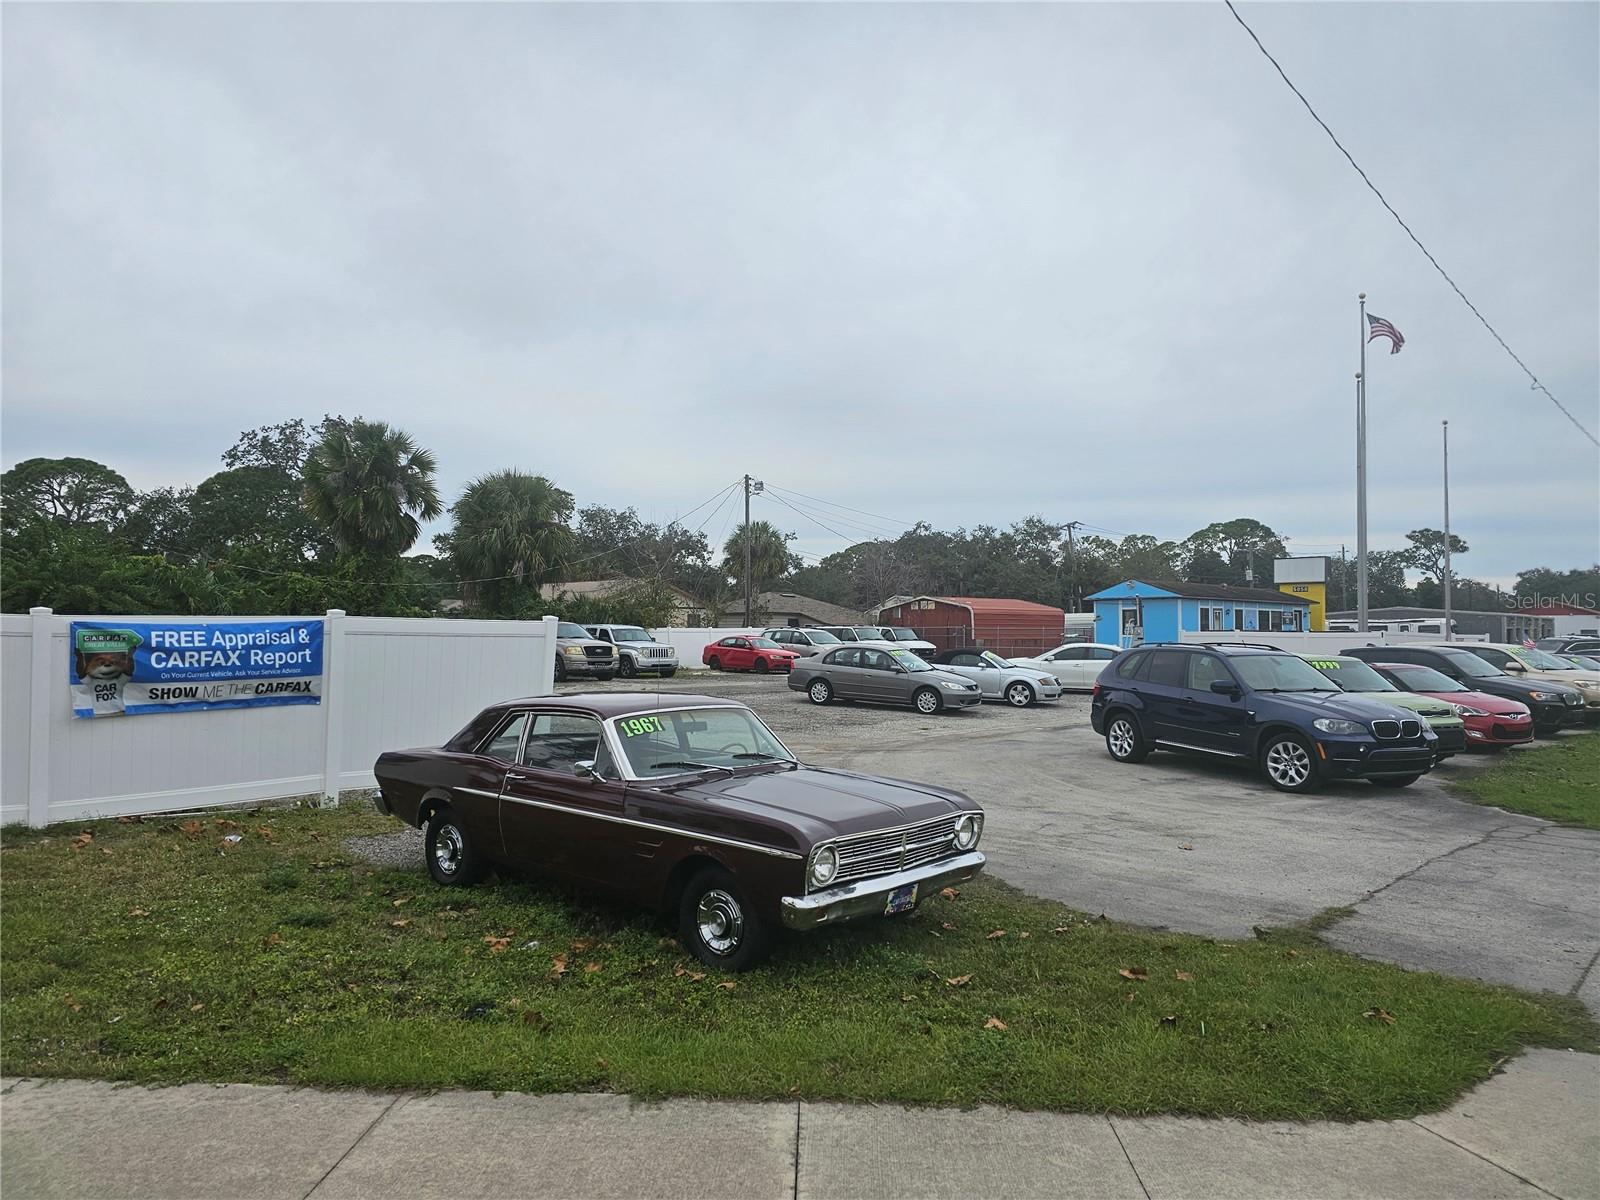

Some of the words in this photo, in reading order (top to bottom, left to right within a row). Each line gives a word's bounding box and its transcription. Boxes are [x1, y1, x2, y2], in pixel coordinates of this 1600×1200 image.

[150, 631, 207, 648] FREE
[211, 628, 295, 650] Appraisal
[298, 628, 310, 643] &
[250, 649, 312, 668] Report
[172, 671, 185, 679] Your
[94, 683, 117, 693] CAR
[96, 692, 117, 702] FOX
[149, 686, 199, 700] SHOW
[203, 685, 224, 698] ME
[228, 683, 251, 696] THE
[254, 681, 312, 694] CARFAX
[620, 716, 664, 738] 1967
